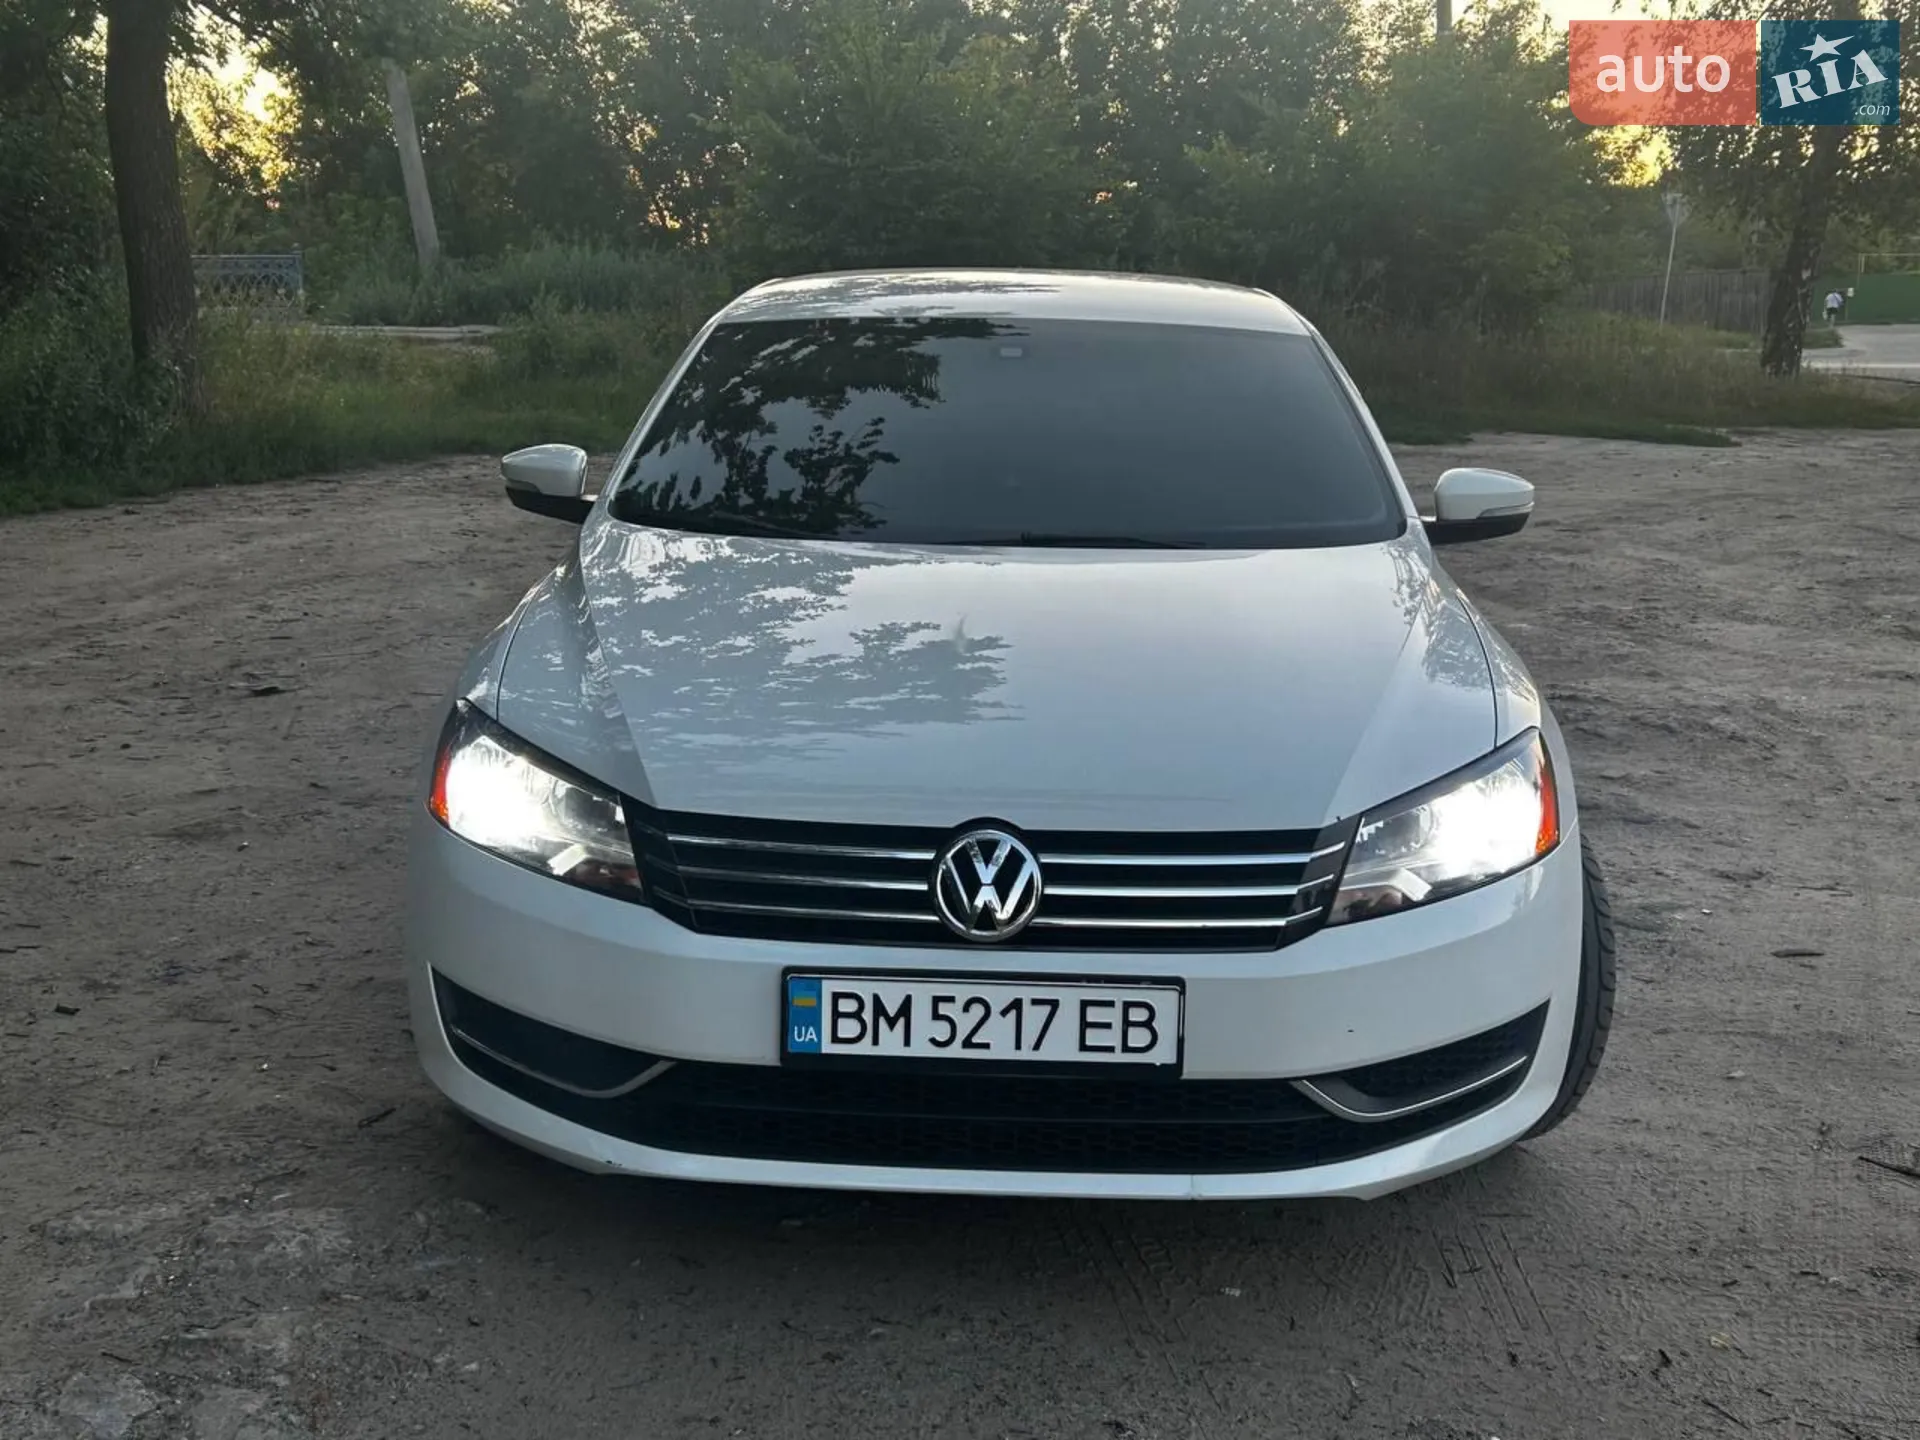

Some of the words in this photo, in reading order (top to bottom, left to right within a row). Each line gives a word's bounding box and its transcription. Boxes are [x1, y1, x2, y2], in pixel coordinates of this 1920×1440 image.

[794, 1026, 818, 1043] UA
[830, 991, 912, 1047] BM
[928, 995, 1060, 1051] 5217
[1078, 999, 1159, 1054] EB
